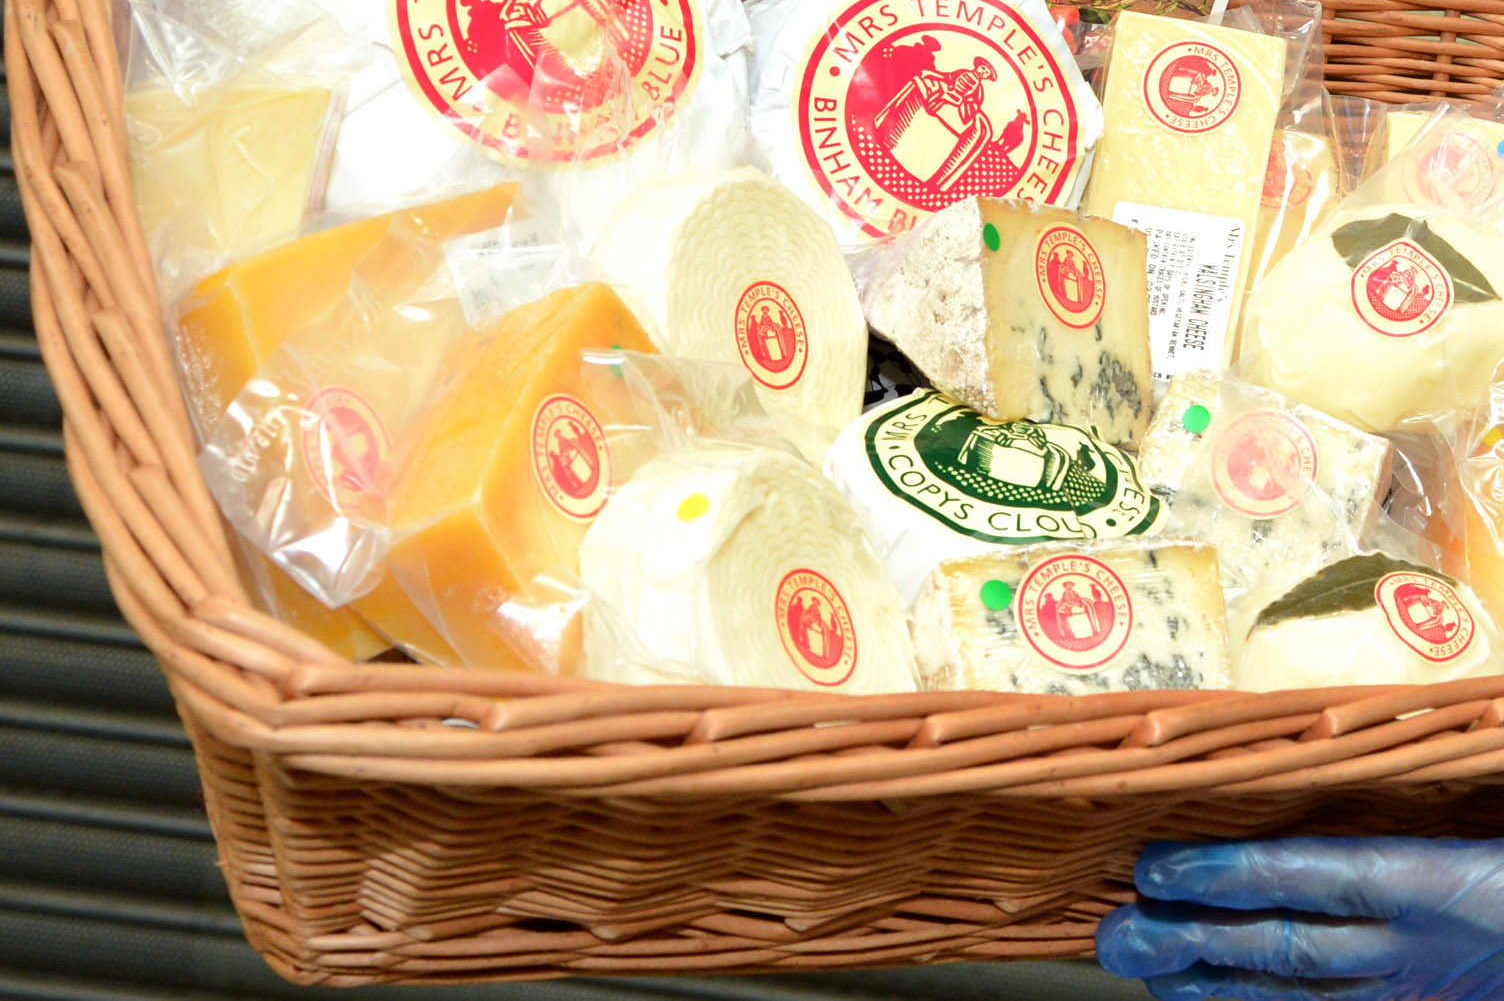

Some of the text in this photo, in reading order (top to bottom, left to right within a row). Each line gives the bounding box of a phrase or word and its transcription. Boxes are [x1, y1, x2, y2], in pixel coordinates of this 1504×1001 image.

[418, 23, 474, 102] MRS
[641, 26, 683, 102] BLUE
[1169, 47, 1237, 129] MRS TEMPLE'S CHEESE
[833, 3, 899, 63] MRS
[1016, 108, 1065, 202] CHEES
[813, 96, 884, 215] BINHAM
[1039, 231, 1103, 302] MRS TEMPLE'S CHEESE
[1217, 227, 1240, 302] Mrs Temple's
[1363, 246, 1445, 322] MRS TEMPLE'S CHEESE
[738, 286, 805, 348] MRS TEMPLE'S CHEESE
[1183, 264, 1219, 351] WALSINGHAM CHEESE
[881, 413, 928, 441] MRS
[888, 454, 975, 521] COPYS
[1024, 561, 1127, 630] MRS TEMPLE'S CHEESE
[1433, 627, 1469, 656] CHEESE
